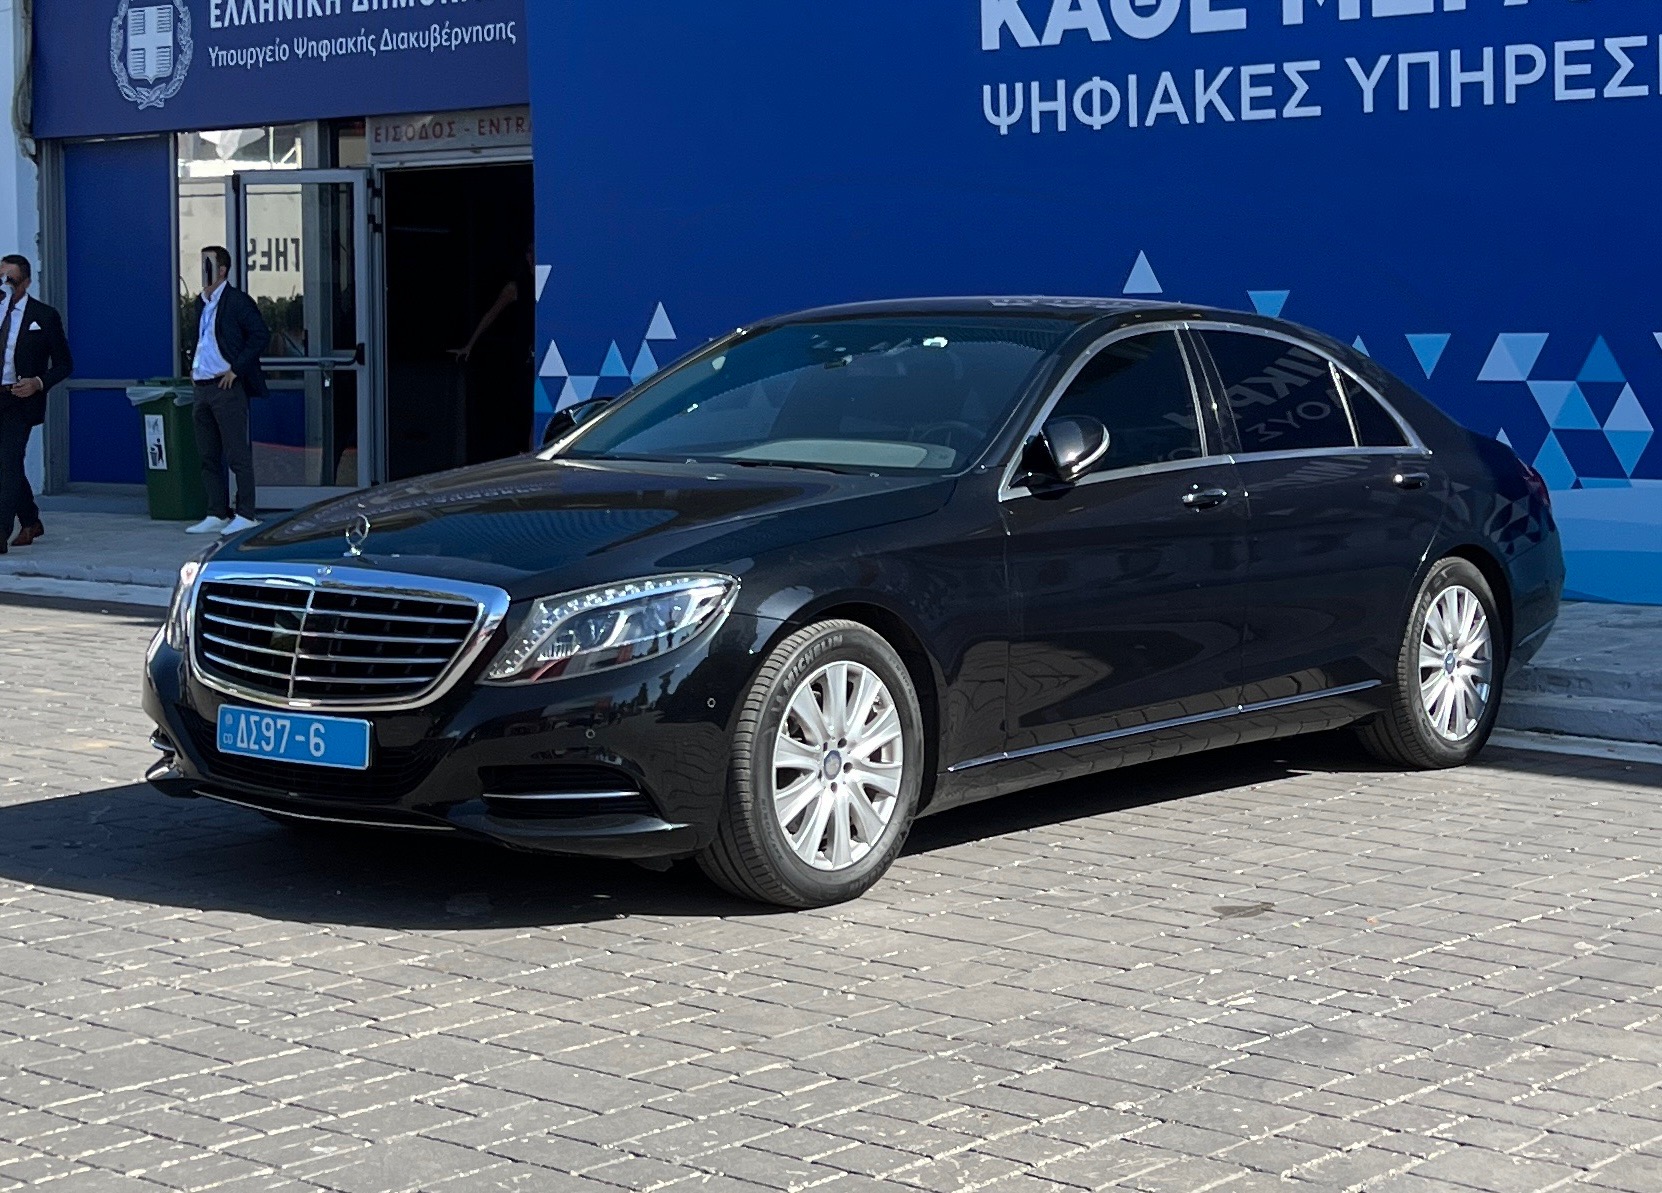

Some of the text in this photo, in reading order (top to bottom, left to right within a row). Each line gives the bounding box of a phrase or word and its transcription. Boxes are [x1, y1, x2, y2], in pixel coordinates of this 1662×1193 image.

[208, 20, 517, 70] Υπουργείο Ψηφιακής Διακυβέρνησης
[982, 59, 1323, 136] ΨΗΦΙΑΚΕΣ
[374, 120, 456, 143] ΕΙΣΟΔΟΣ
